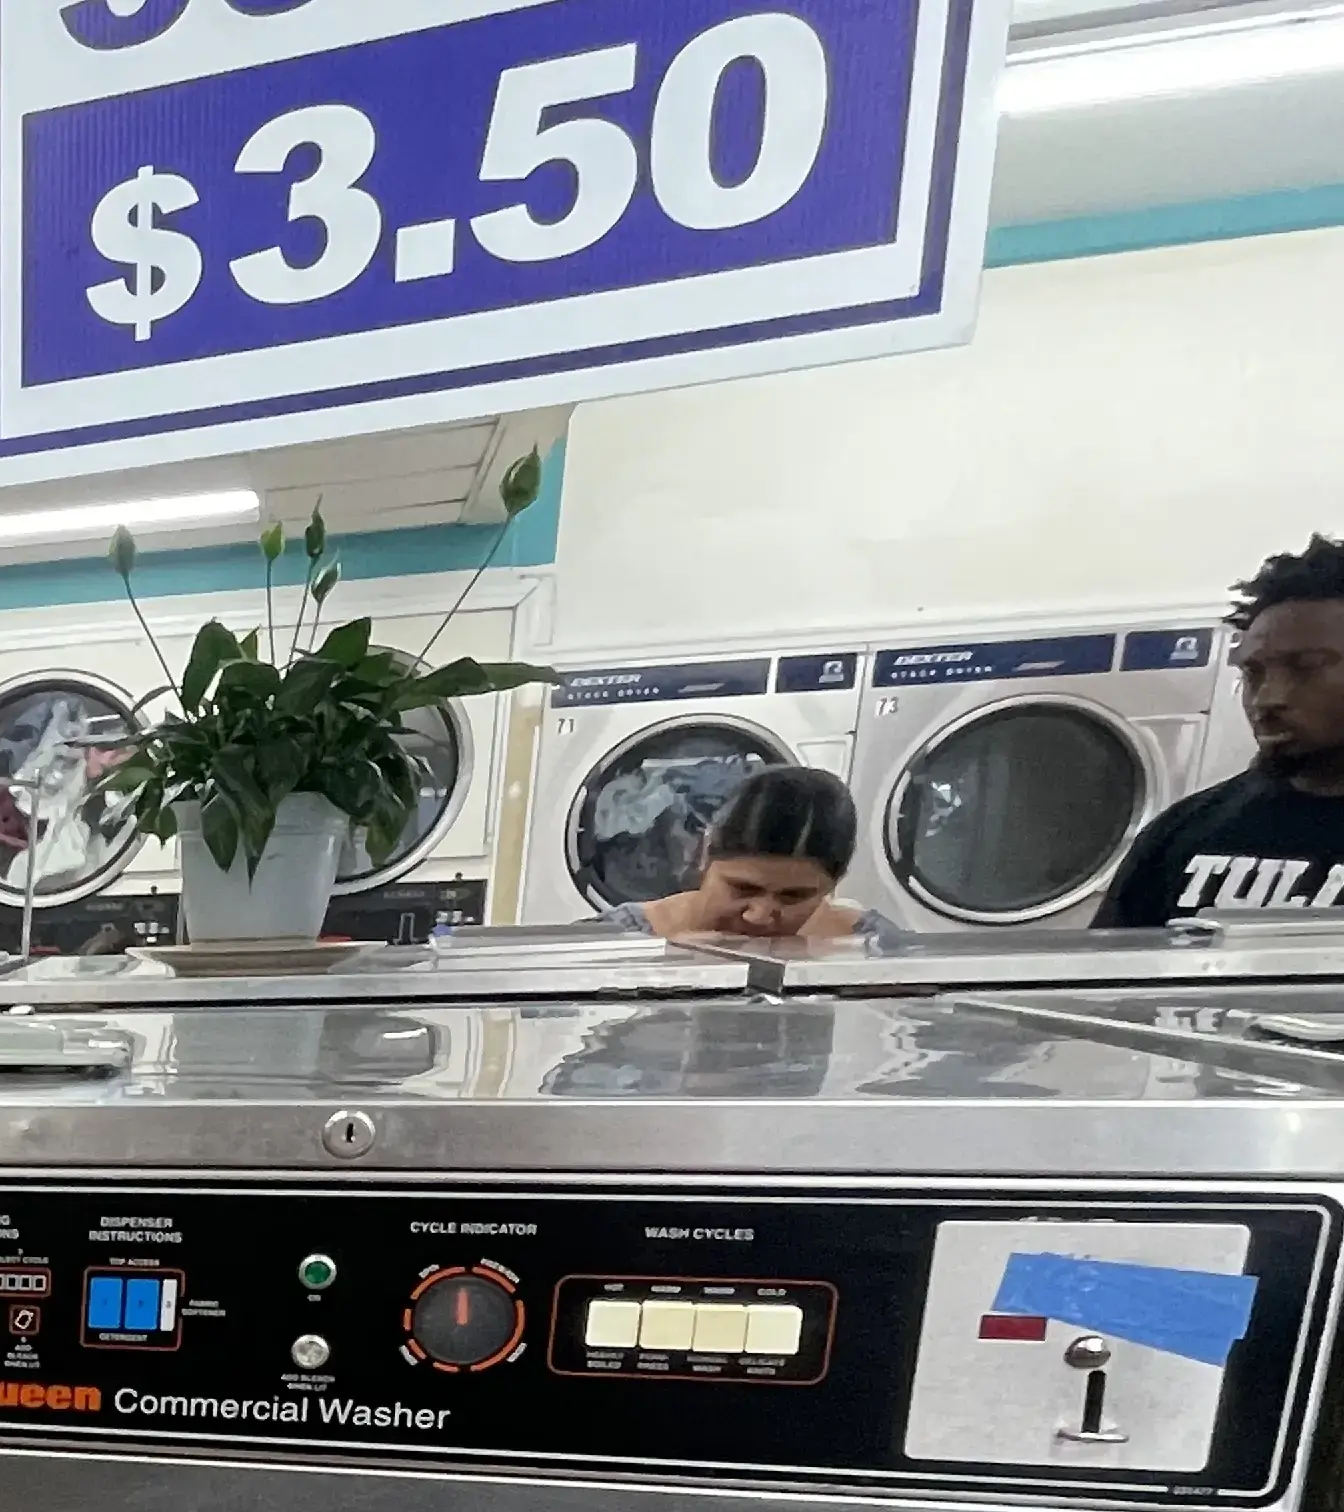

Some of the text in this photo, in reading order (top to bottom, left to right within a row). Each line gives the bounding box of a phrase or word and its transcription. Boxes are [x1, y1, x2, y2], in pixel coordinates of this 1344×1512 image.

[85, 12, 827, 341] $3.50
[893, 650, 974, 666] DEXTER
[569, 673, 643, 687] DEXTER
[558, 718, 575, 735] 71
[100, 1216, 173, 1229] DISPENSER
[410, 1221, 538, 1236] CYCLE INDICATOR
[88, 1230, 183, 1244] INSTRUCTIONS
[644, 1226, 755, 1242] WASH CYCLES
[113, 1387, 309, 1423] Commercial
[317, 1397, 452, 1430] Washer
